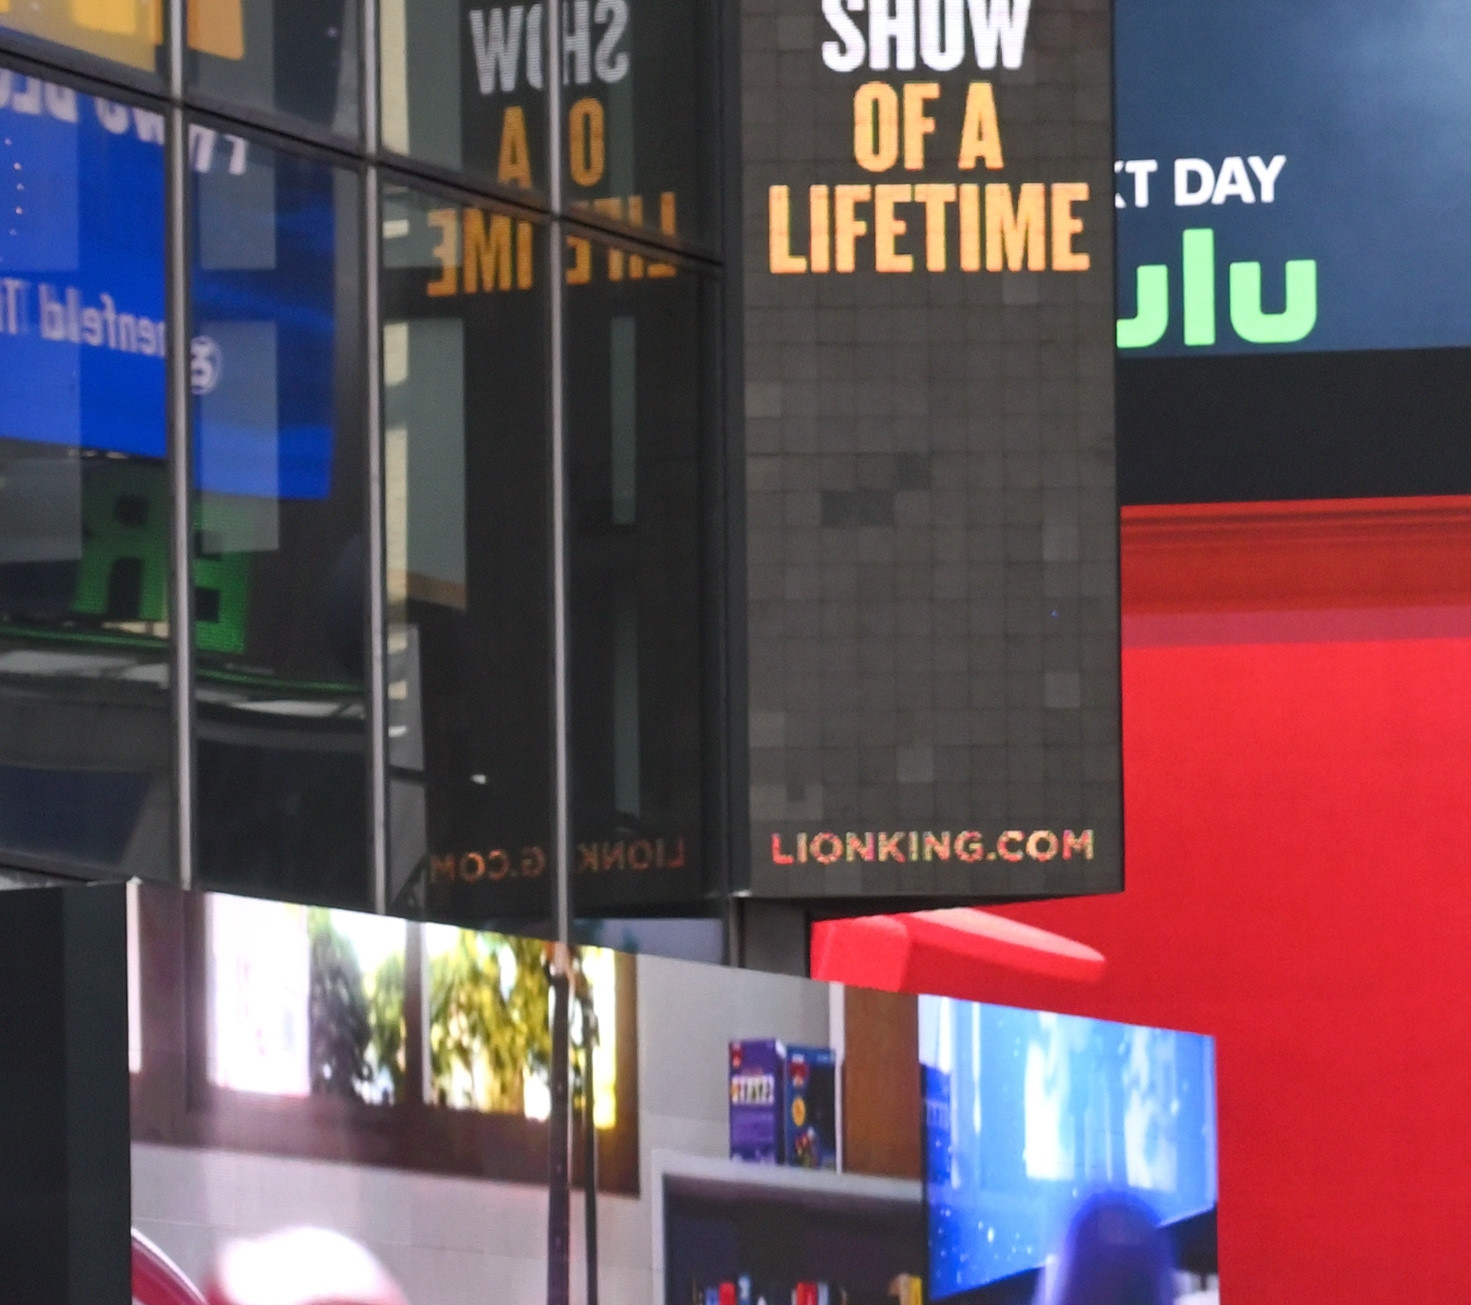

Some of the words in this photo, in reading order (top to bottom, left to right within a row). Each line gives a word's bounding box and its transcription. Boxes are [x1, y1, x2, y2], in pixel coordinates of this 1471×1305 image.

[821, 0, 1032, 72] SHOW
[853, 83, 940, 171] OF
[957, 83, 1003, 171] A
[1173, 156, 1287, 206] DAY
[769, 183, 1091, 275] LIFETIME
[771, 829, 1094, 866] LIONKING.COM
